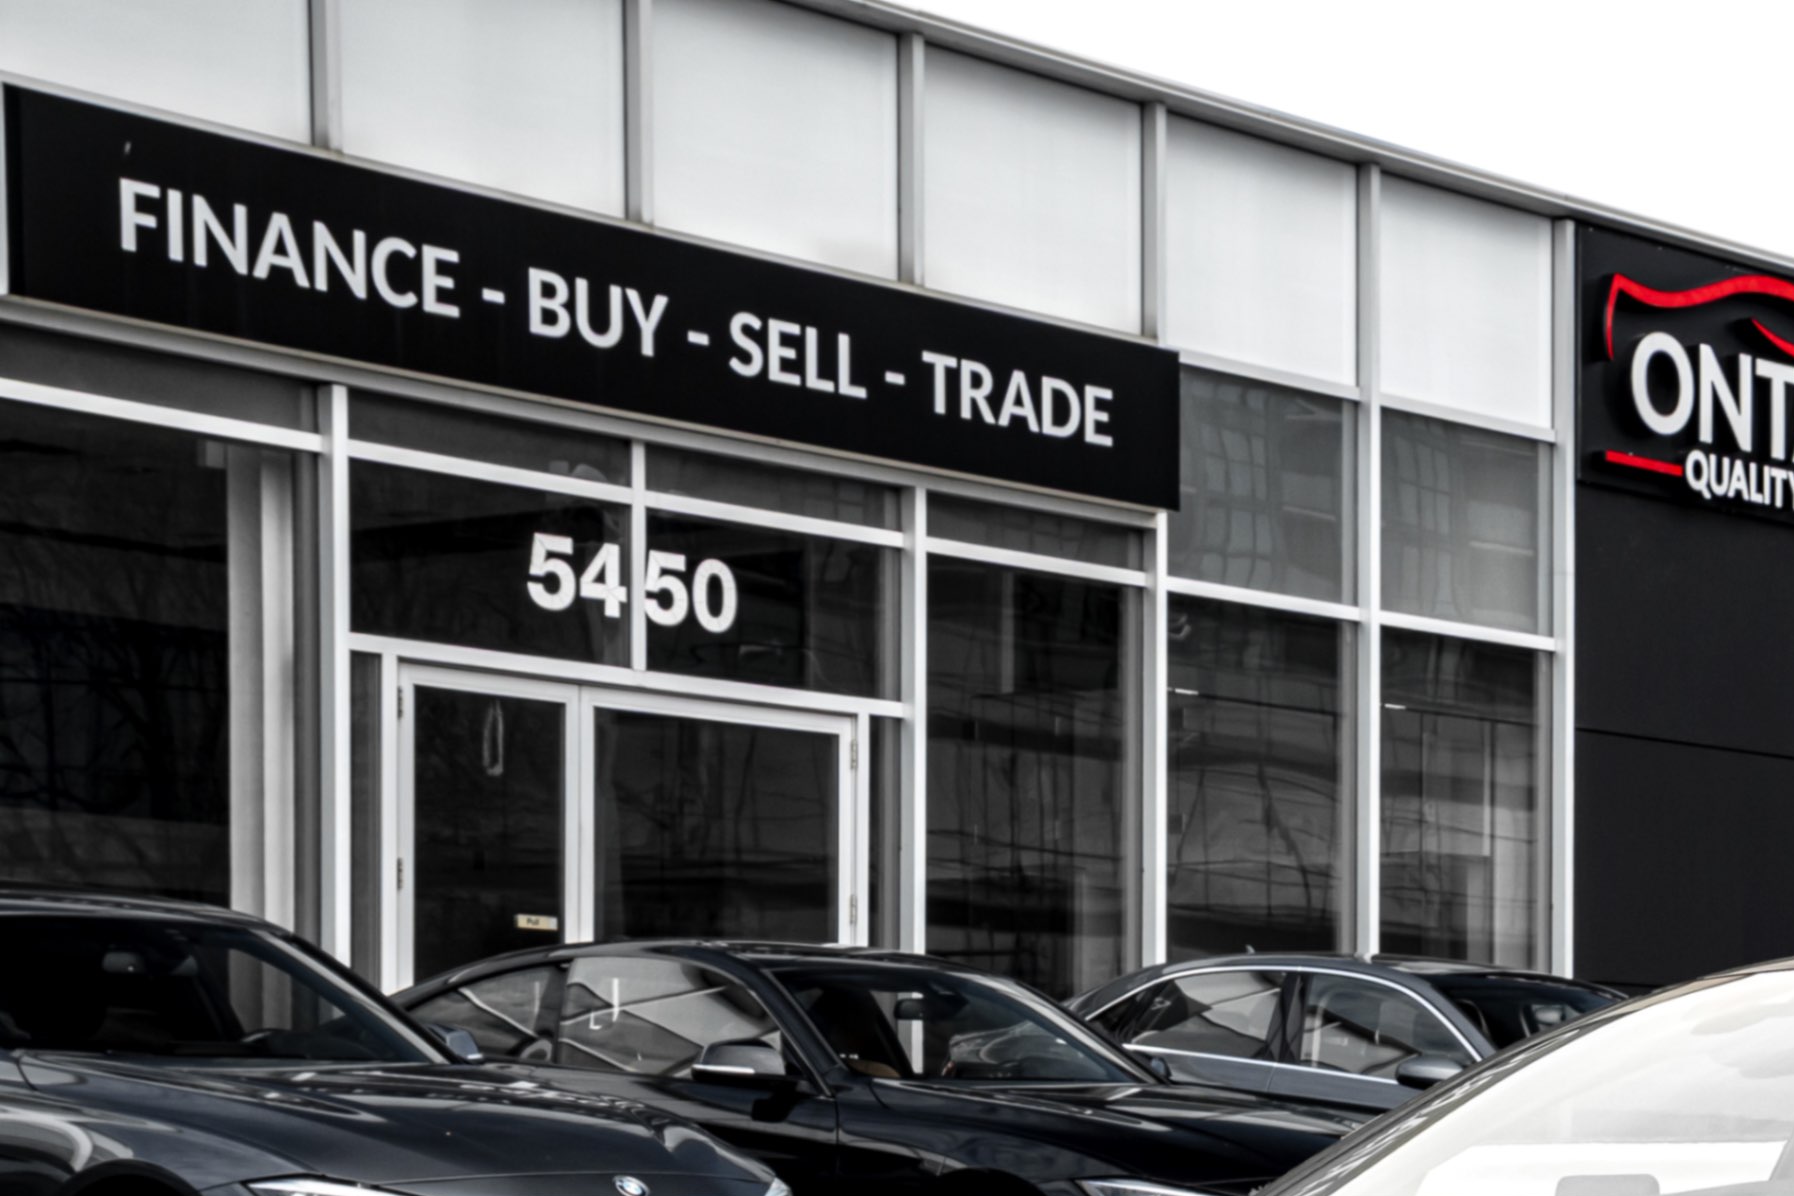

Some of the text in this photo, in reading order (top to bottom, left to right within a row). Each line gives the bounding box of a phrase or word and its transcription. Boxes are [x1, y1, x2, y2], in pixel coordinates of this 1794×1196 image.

[118, 177, 460, 319] FINANCE
[527, 267, 669, 358] BUY
[728, 311, 867, 399] SELL
[921, 350, 1114, 447] TRADE
[526, 532, 737, 633] 5450
